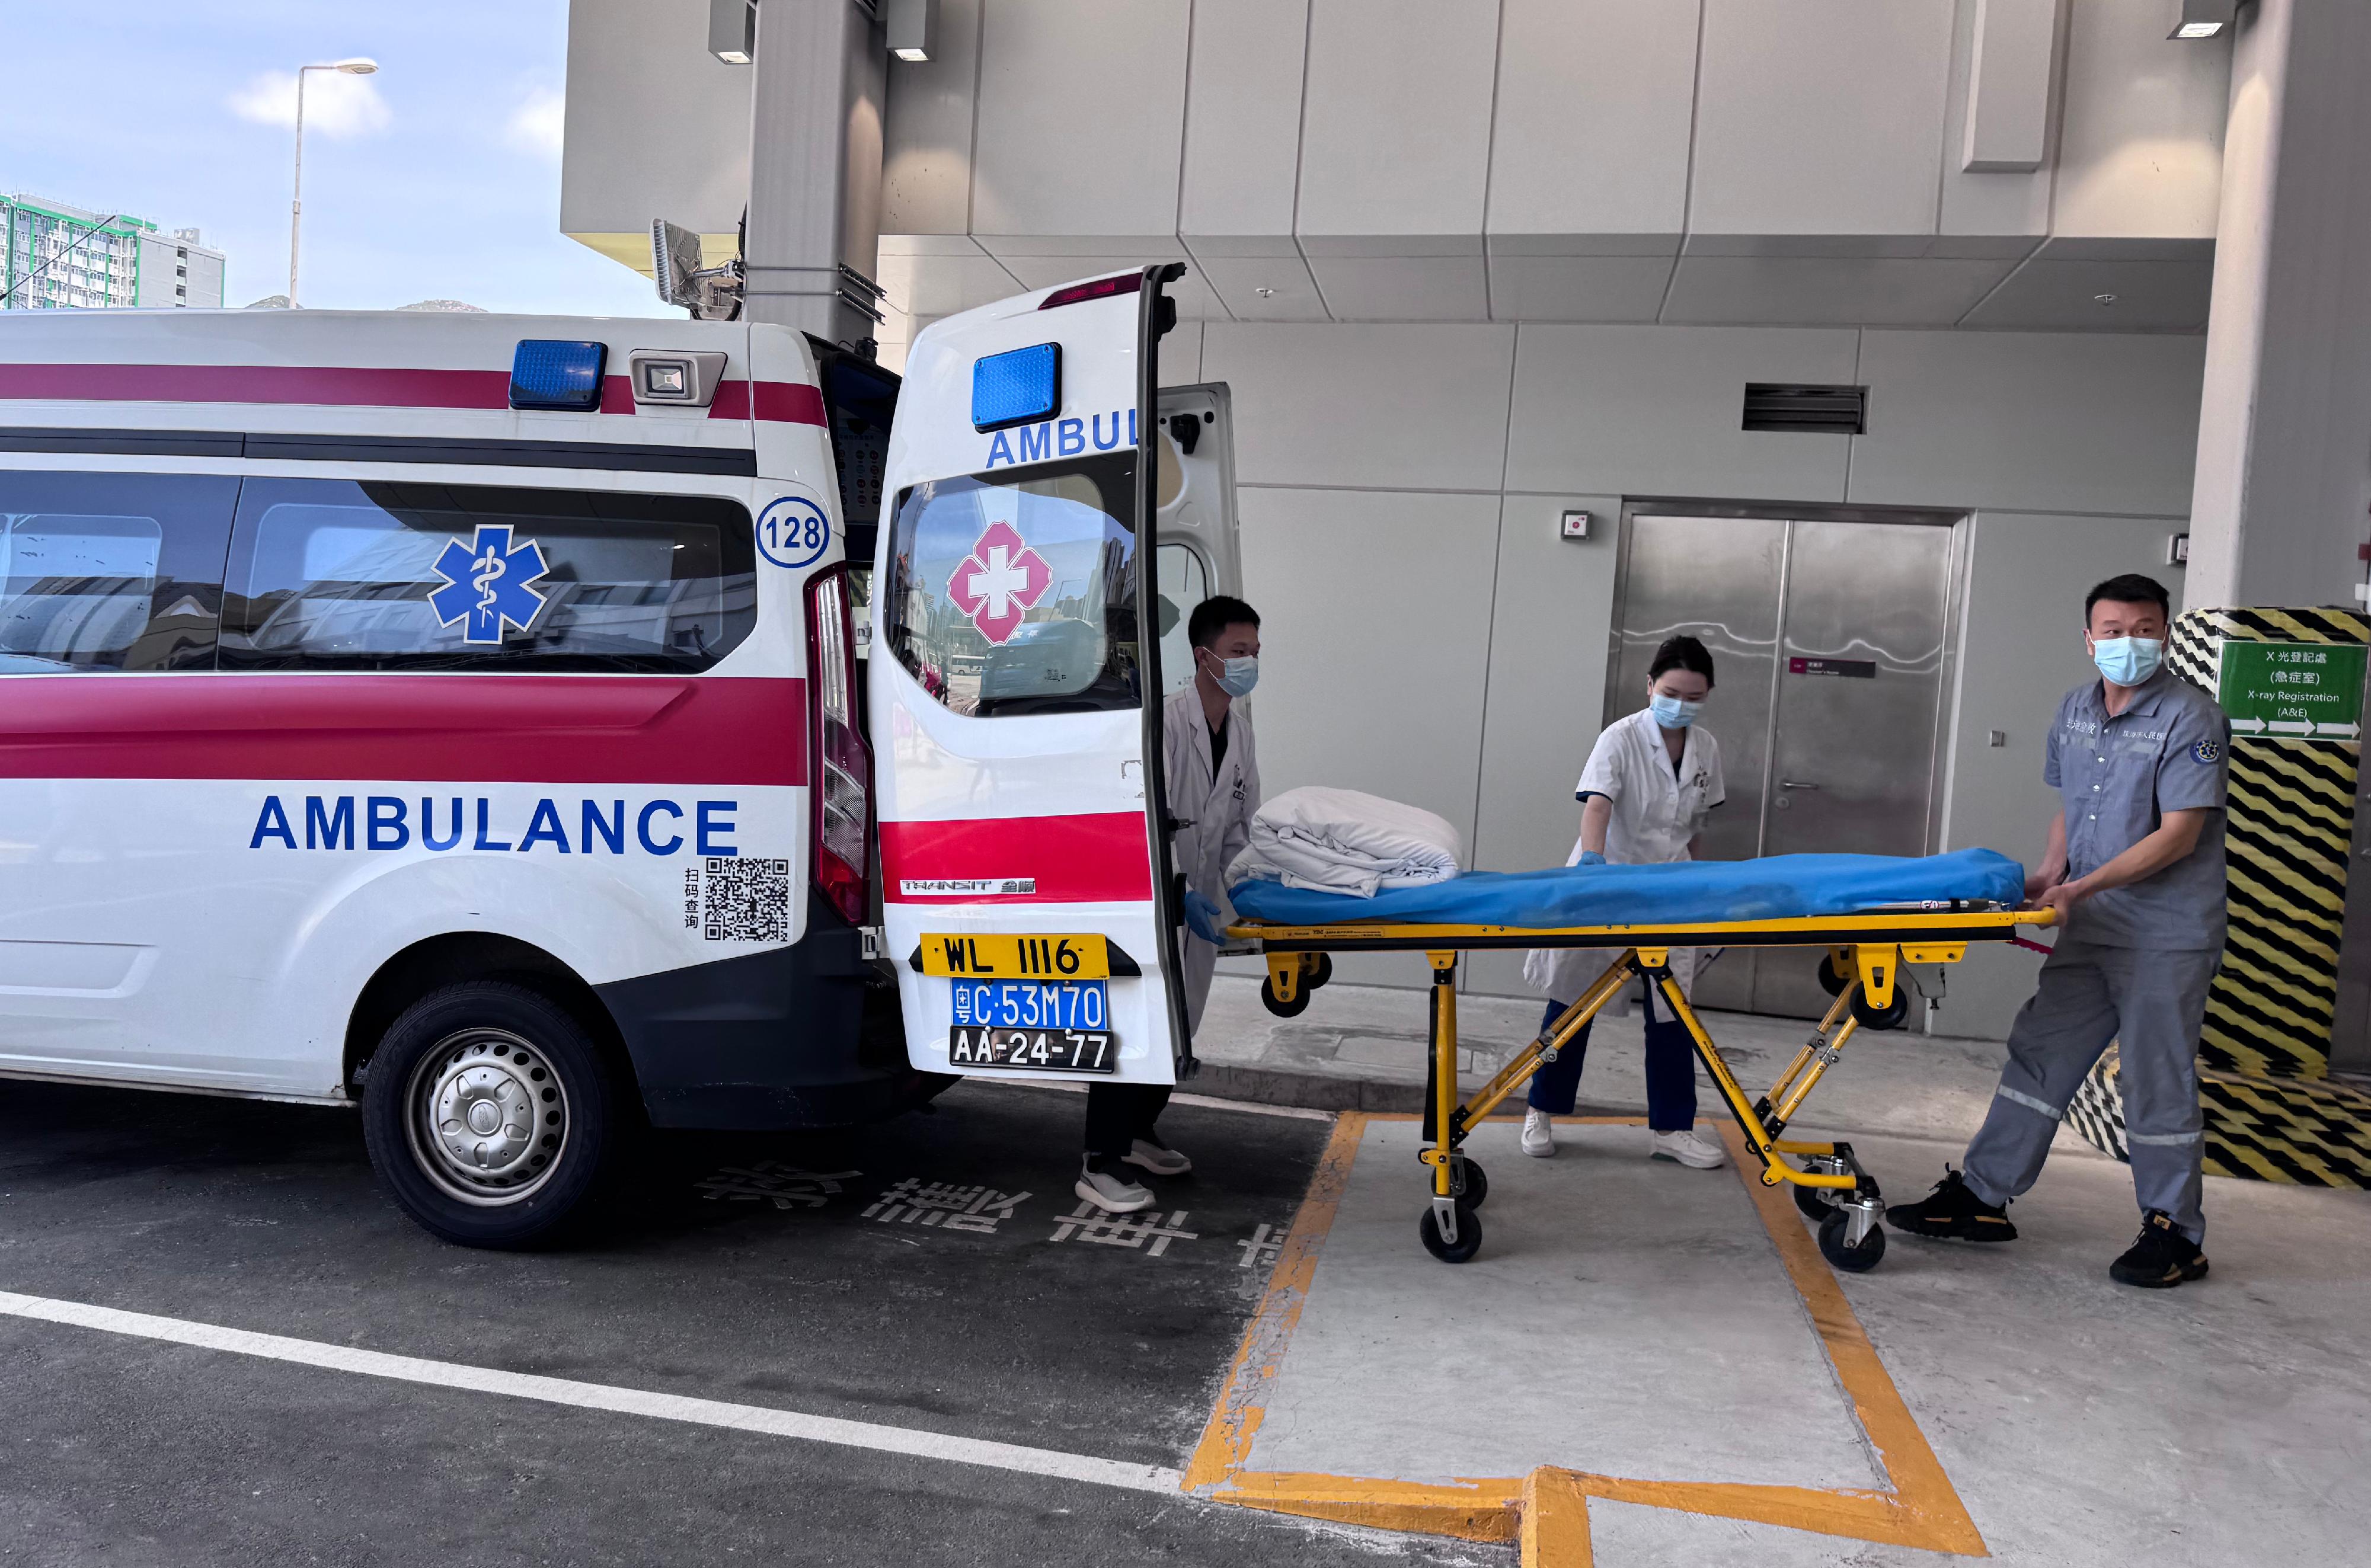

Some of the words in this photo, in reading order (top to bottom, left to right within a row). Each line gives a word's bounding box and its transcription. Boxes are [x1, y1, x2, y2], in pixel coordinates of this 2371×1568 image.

[766, 516, 820, 549] 128
[2270, 671, 2320, 686] (急症室)
[2248, 690, 2275, 702] X-ray
[2278, 691, 2340, 702] Registration
[2277, 708, 2308, 718] (A&E)
[250, 796, 737, 856] AMBULANCE
[685, 868, 699, 929] 扫码查询
[902, 881, 991, 890] TRANSIT
[944, 938, 993, 972] WL
[1018, 938, 1080, 974] 1116
[954, 1030, 1107, 1068] AA-24-77
